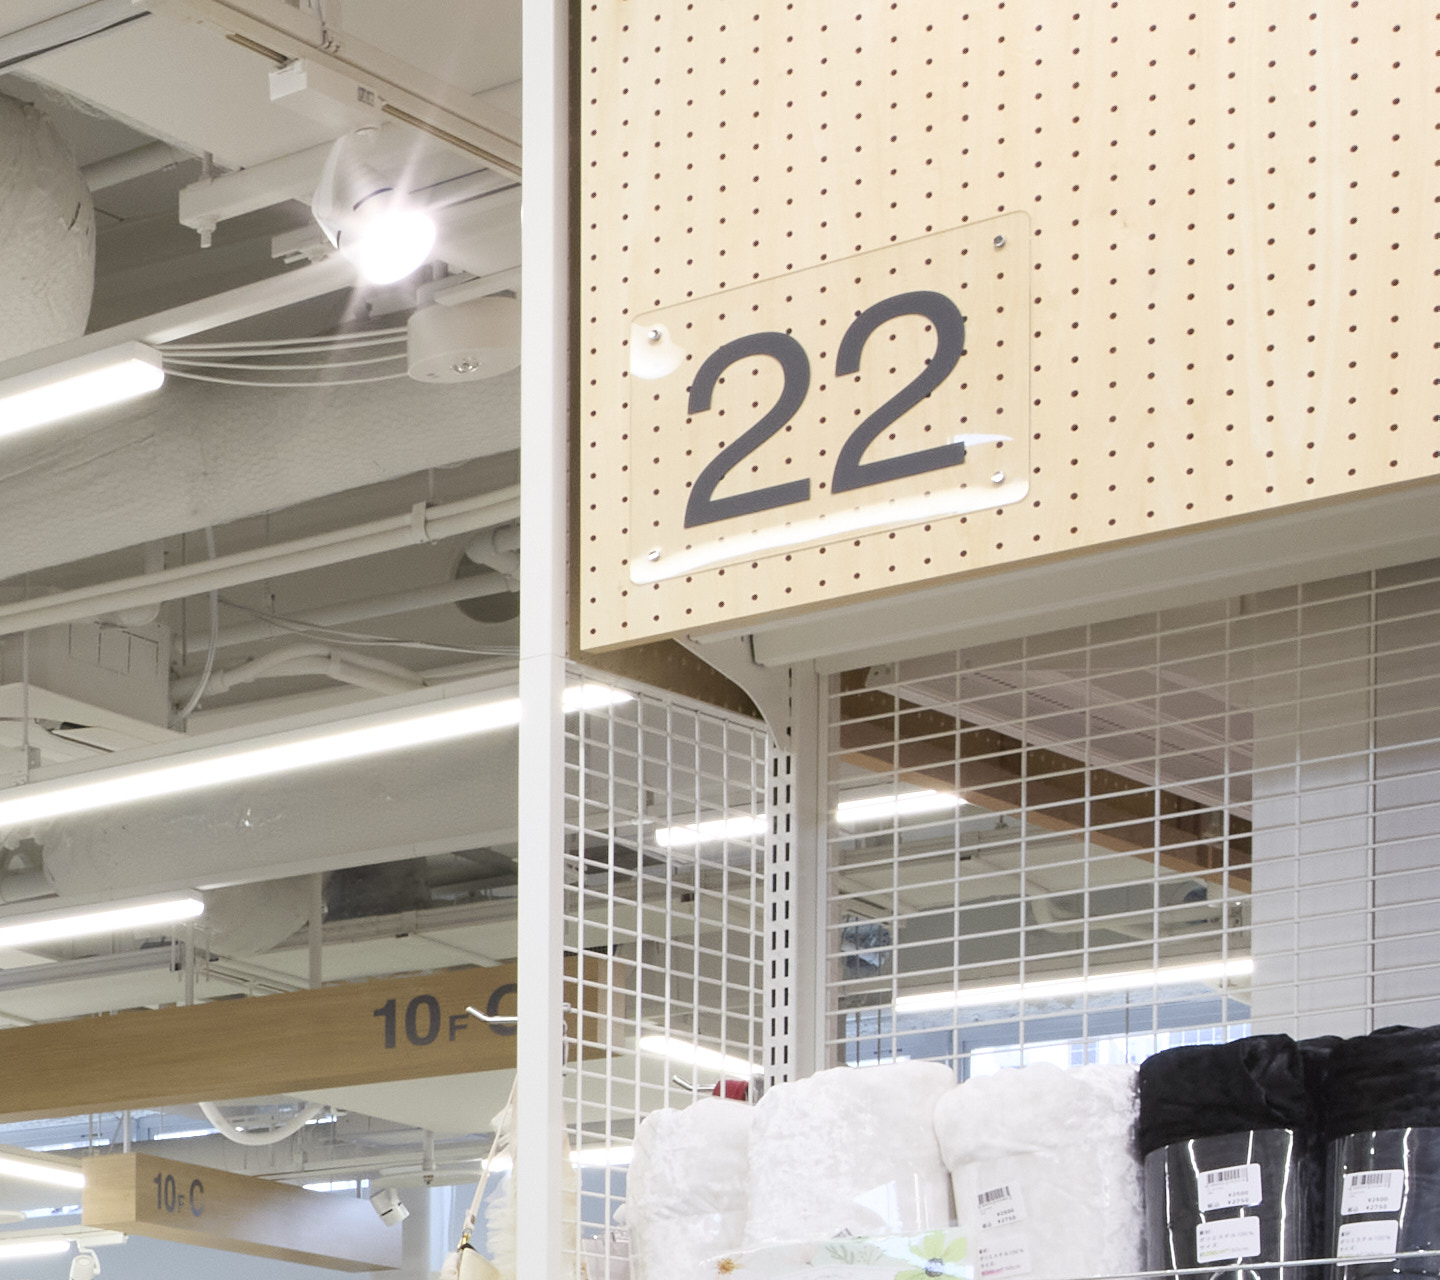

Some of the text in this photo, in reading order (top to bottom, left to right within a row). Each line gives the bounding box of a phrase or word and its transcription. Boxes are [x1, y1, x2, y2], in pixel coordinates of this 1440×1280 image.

[684, 290, 968, 529] 22
[373, 994, 469, 1049] 10F
[189, 1179, 205, 1217] C
